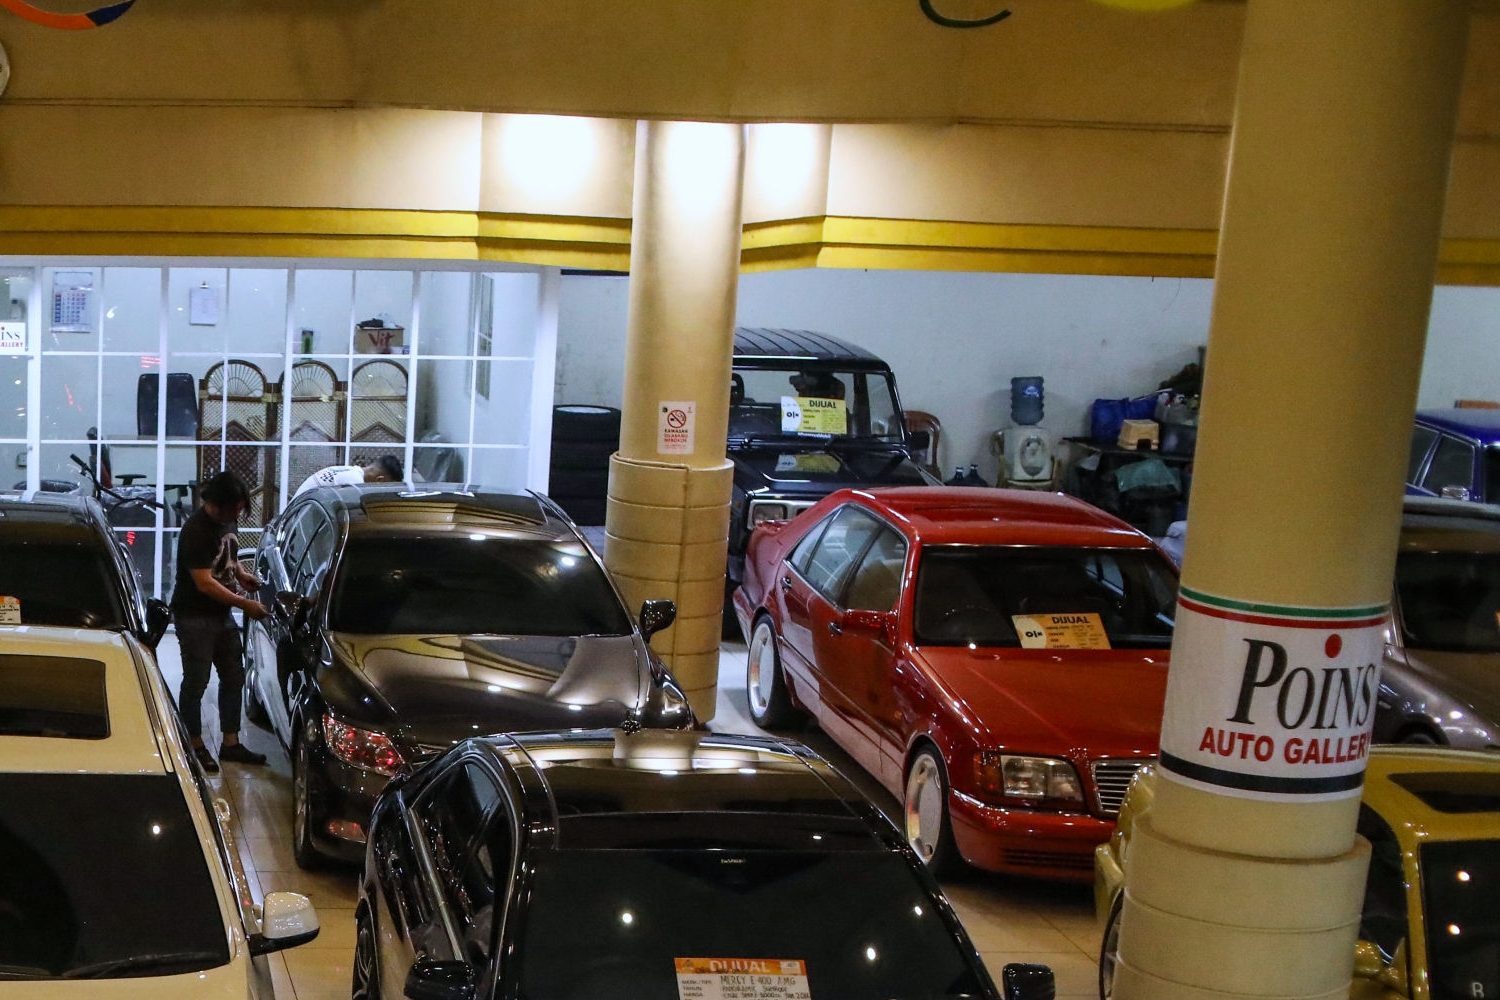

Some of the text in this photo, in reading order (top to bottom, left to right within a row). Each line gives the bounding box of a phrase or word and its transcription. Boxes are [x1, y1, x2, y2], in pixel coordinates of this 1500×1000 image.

[809, 399, 837, 409] DIJUAL
[1052, 616, 1090, 624] DIJUAL
[1199, 727, 1274, 762] AUTO
